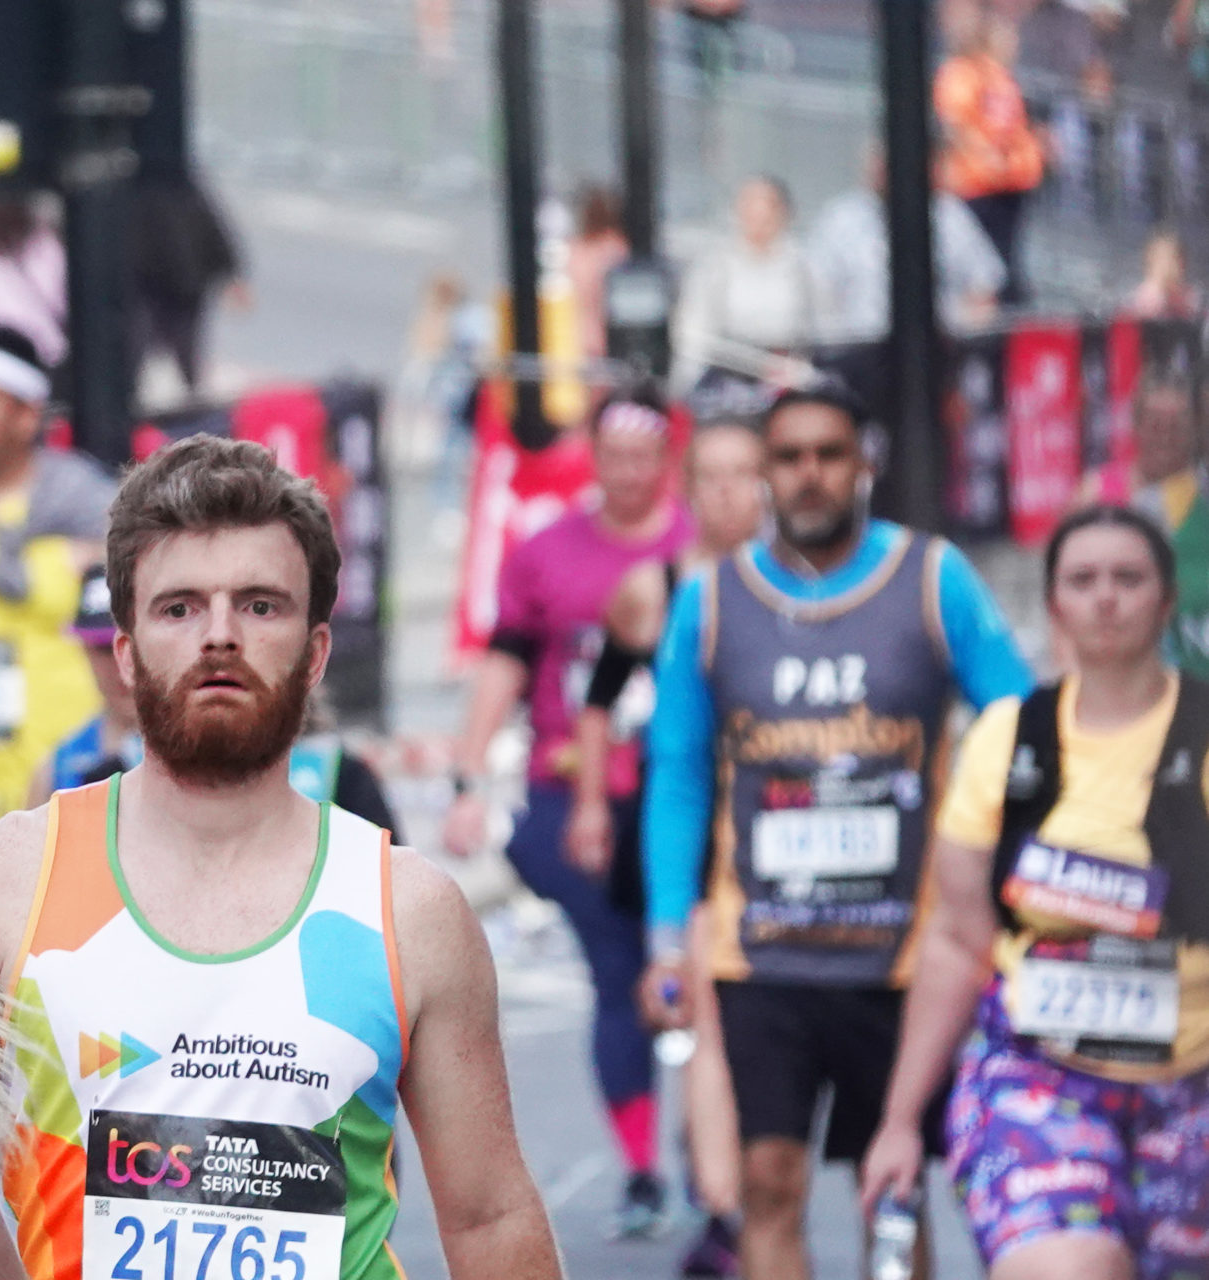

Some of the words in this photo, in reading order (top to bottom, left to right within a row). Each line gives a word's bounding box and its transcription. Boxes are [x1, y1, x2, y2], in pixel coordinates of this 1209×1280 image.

[171, 1033, 297, 1058] Ambitious
[171, 1061, 241, 1079] about
[245, 1059, 330, 1090] Autism
[205, 1135, 259, 1155] TATA
[107, 1128, 193, 1188] tcs
[203, 1155, 331, 1181] CONSULTANCY
[201, 1174, 282, 1197] SERVICES
